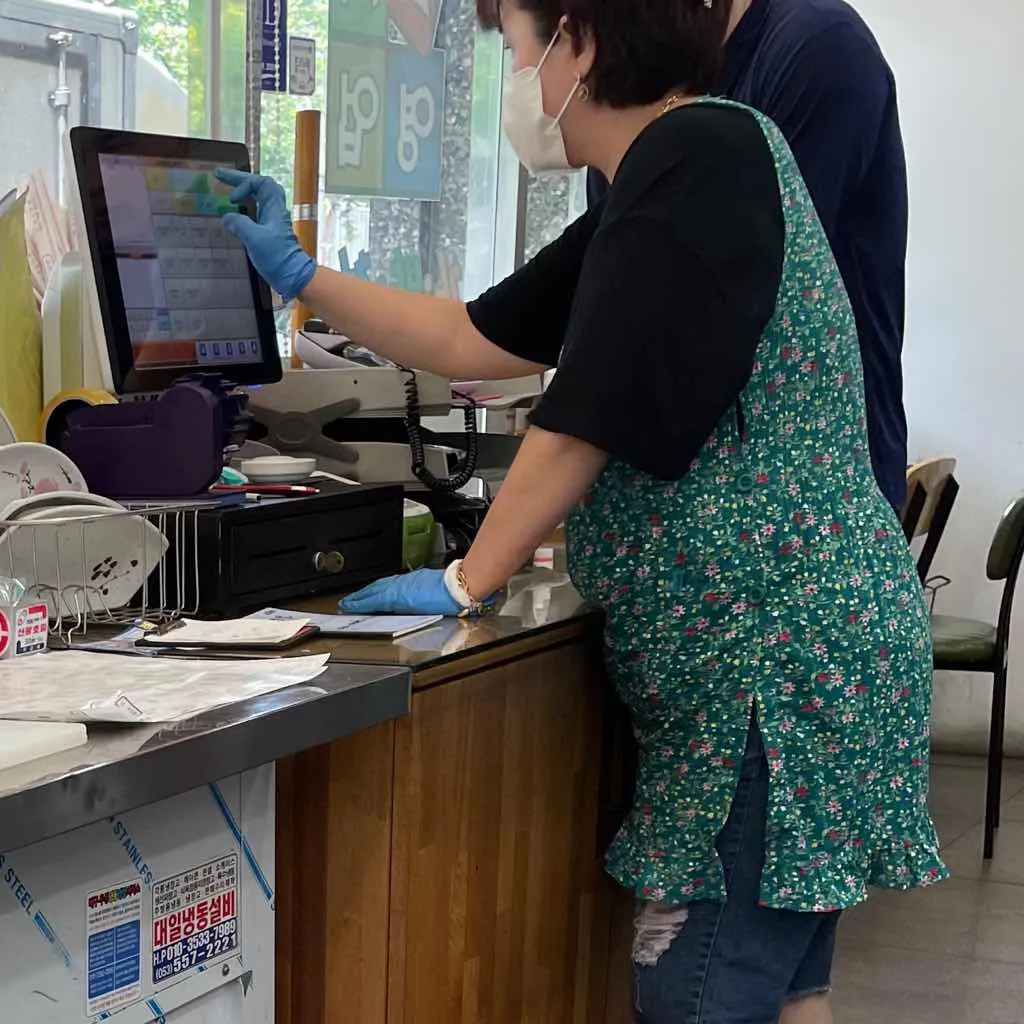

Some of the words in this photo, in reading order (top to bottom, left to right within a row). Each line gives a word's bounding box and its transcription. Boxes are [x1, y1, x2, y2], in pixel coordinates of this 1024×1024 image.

[4, 867, 34, 916] STEEL
[153, 889, 236, 948] 대일냉동설비
[173, 934, 237, 973] 557-2221
